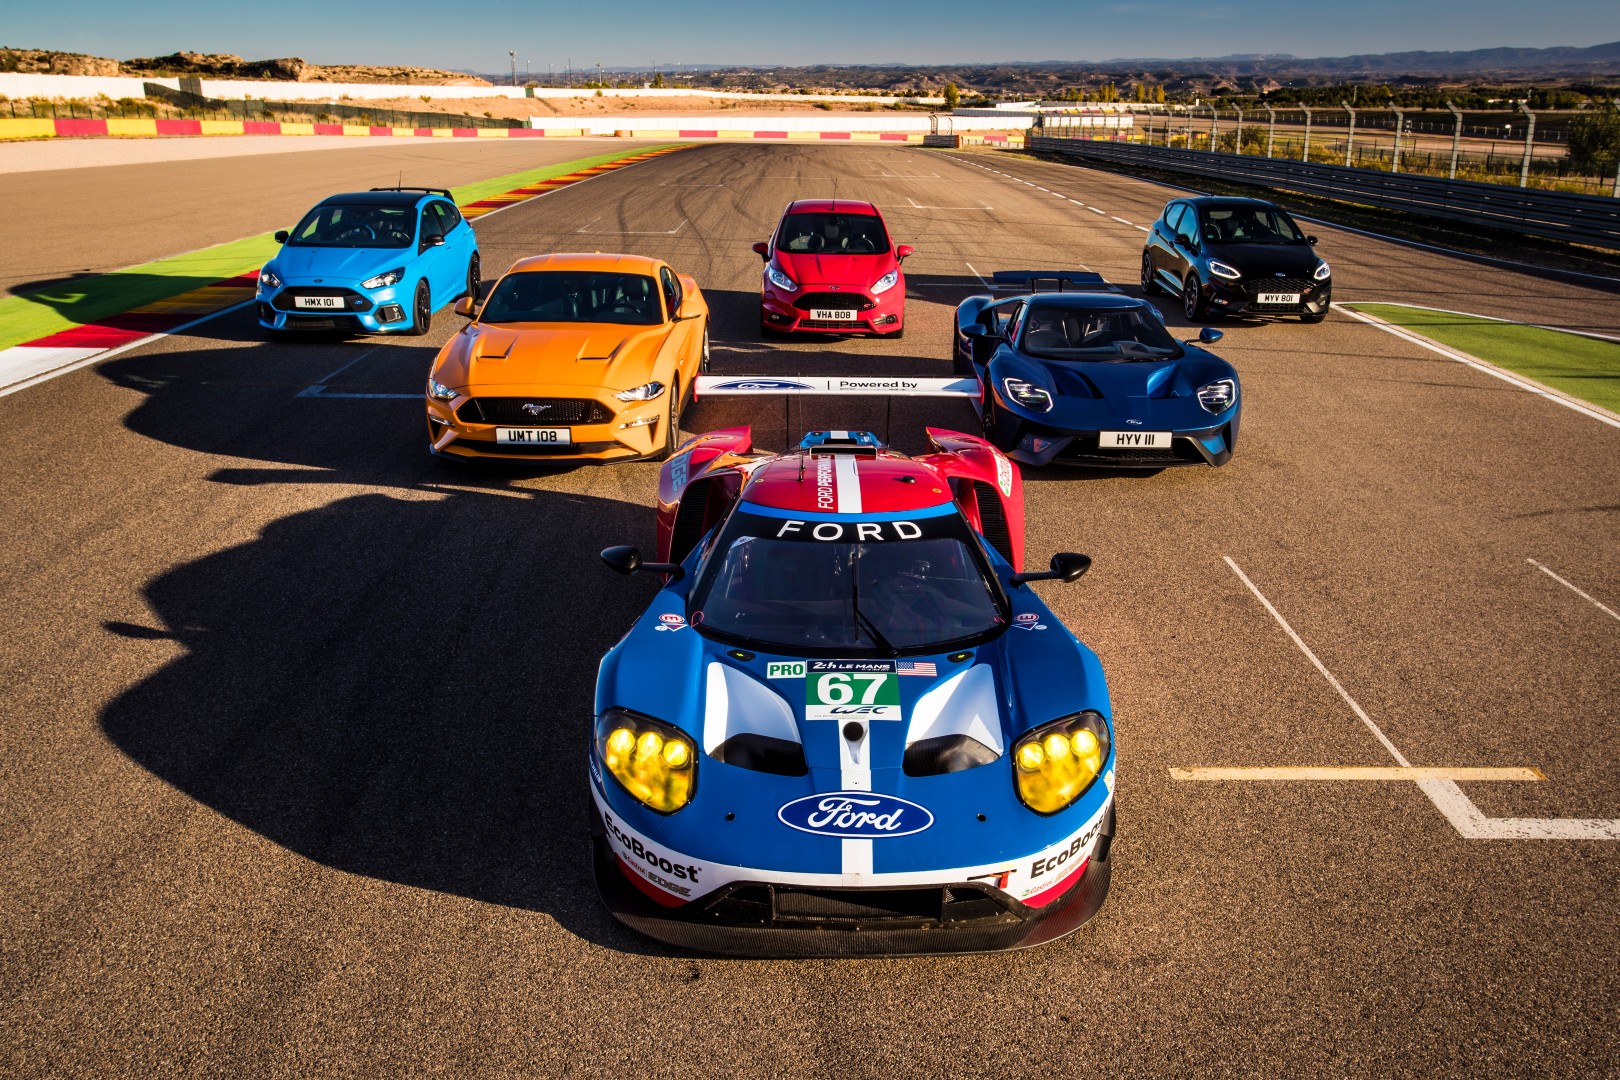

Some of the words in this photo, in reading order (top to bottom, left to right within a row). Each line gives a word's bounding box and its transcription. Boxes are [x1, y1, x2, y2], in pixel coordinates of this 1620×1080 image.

[305, 298, 321, 306] HMX
[817, 310, 833, 319] VHA
[835, 311, 851, 319] 808
[840, 381, 898, 389] Powered
[902, 381, 918, 389] by
[508, 430, 533, 442] UMT
[536, 430, 558, 442] 108
[1116, 433, 1142, 445] HYV
[817, 486, 834, 510] FORD
[776, 519, 922, 541] FORD
[769, 663, 804, 676] PRO
[817, 673, 888, 705] 67
[830, 706, 889, 715] WEC
[808, 797, 904, 831] Ford
[648, 871, 692, 897] EDGE
